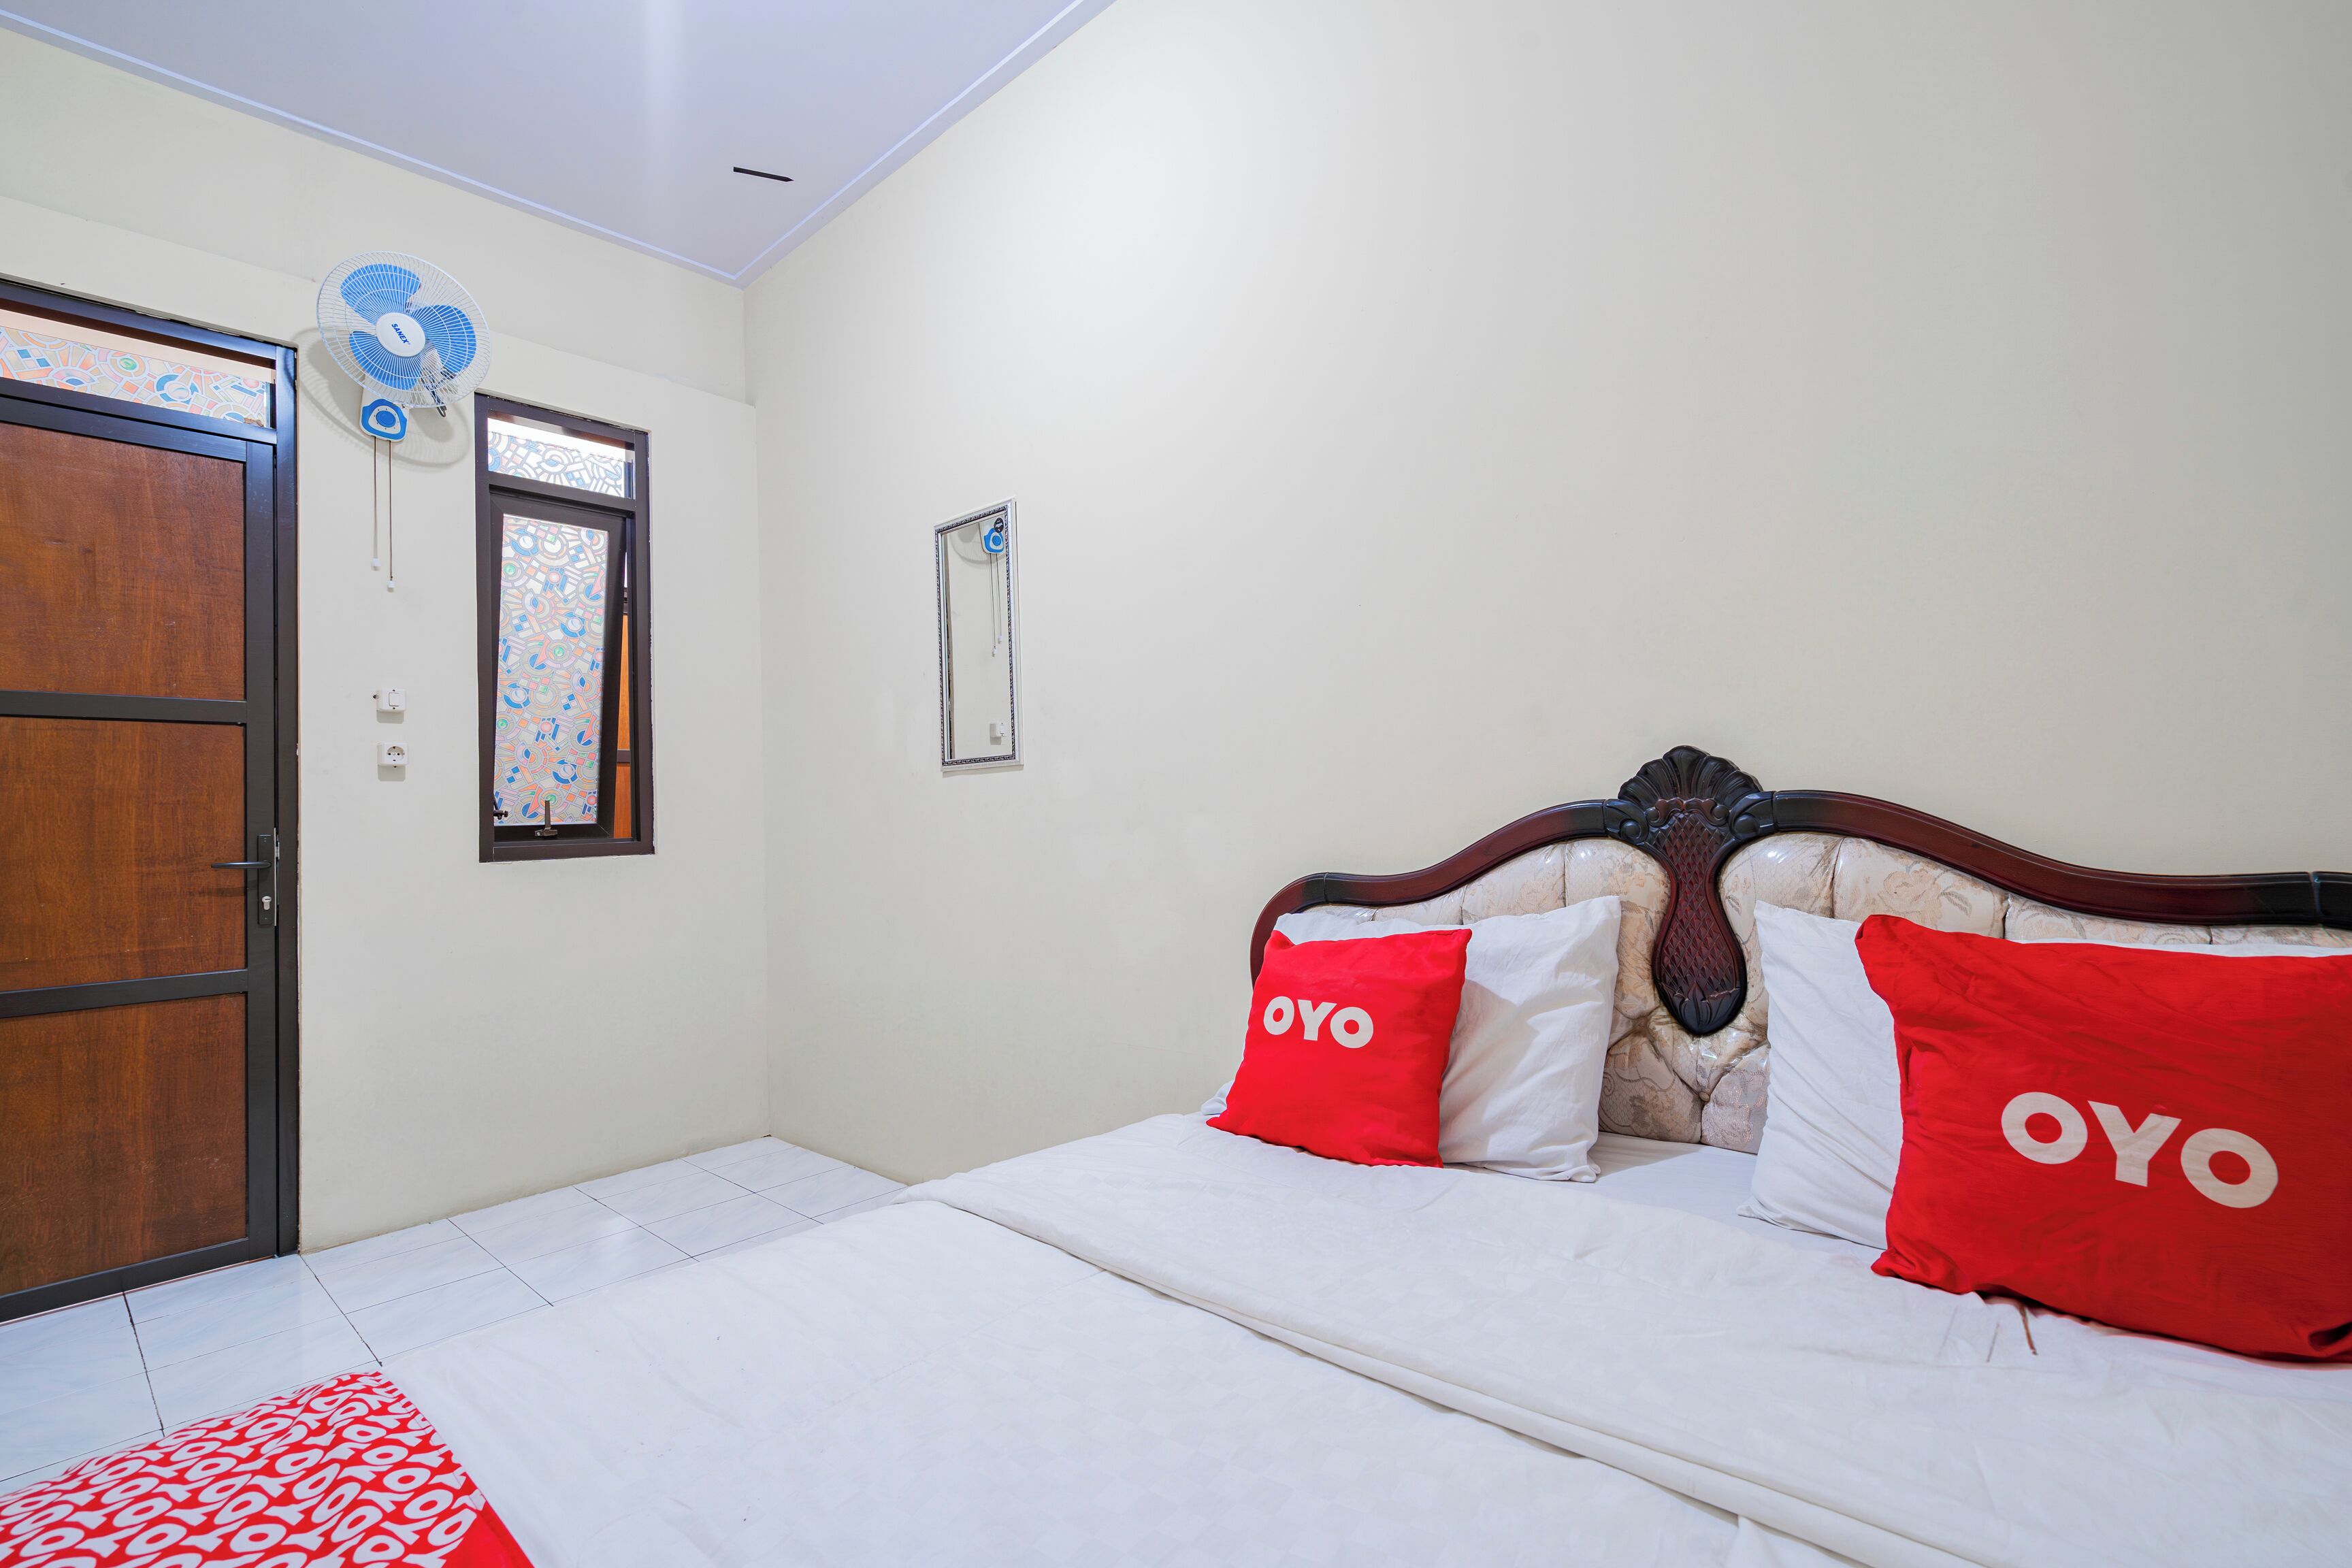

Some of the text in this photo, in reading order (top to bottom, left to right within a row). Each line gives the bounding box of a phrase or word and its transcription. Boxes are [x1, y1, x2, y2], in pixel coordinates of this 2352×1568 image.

[391, 323, 409, 344] SANEX
[1263, 996, 1374, 1049] OYO
[2001, 1092, 2278, 1209] OYO
